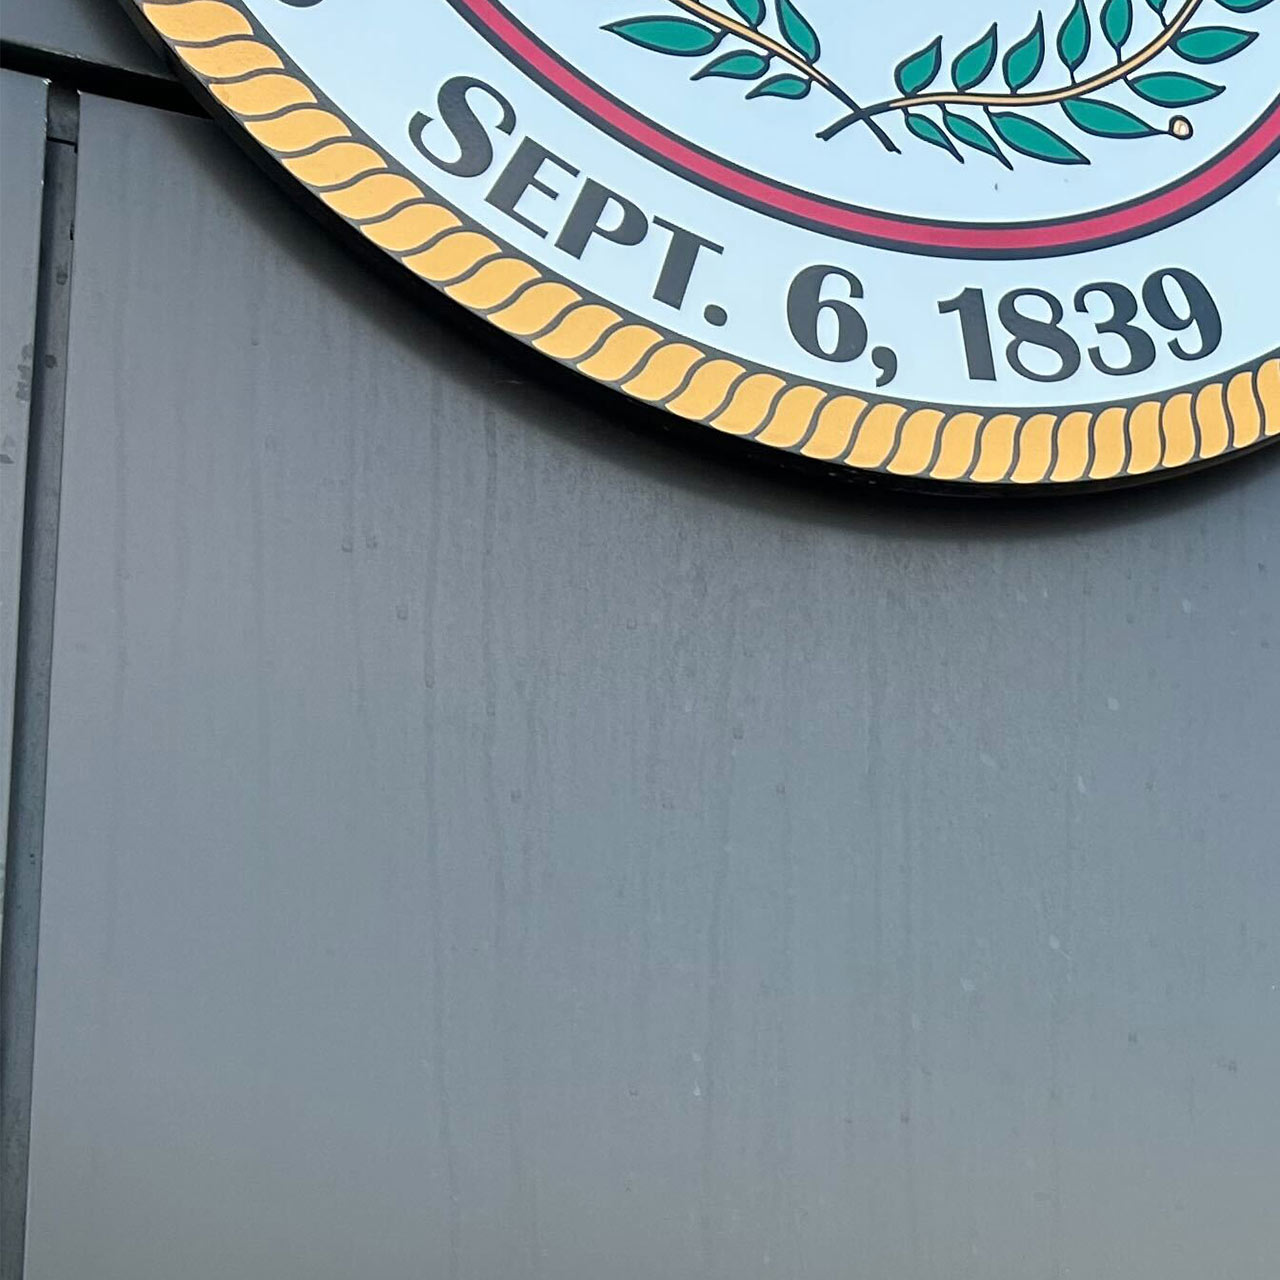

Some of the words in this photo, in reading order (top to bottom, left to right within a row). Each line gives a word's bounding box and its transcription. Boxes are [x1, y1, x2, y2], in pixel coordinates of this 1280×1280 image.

[409, 76, 728, 328] SEPT.
[786, 264, 898, 388] 6,
[937, 267, 1222, 383] 1839
